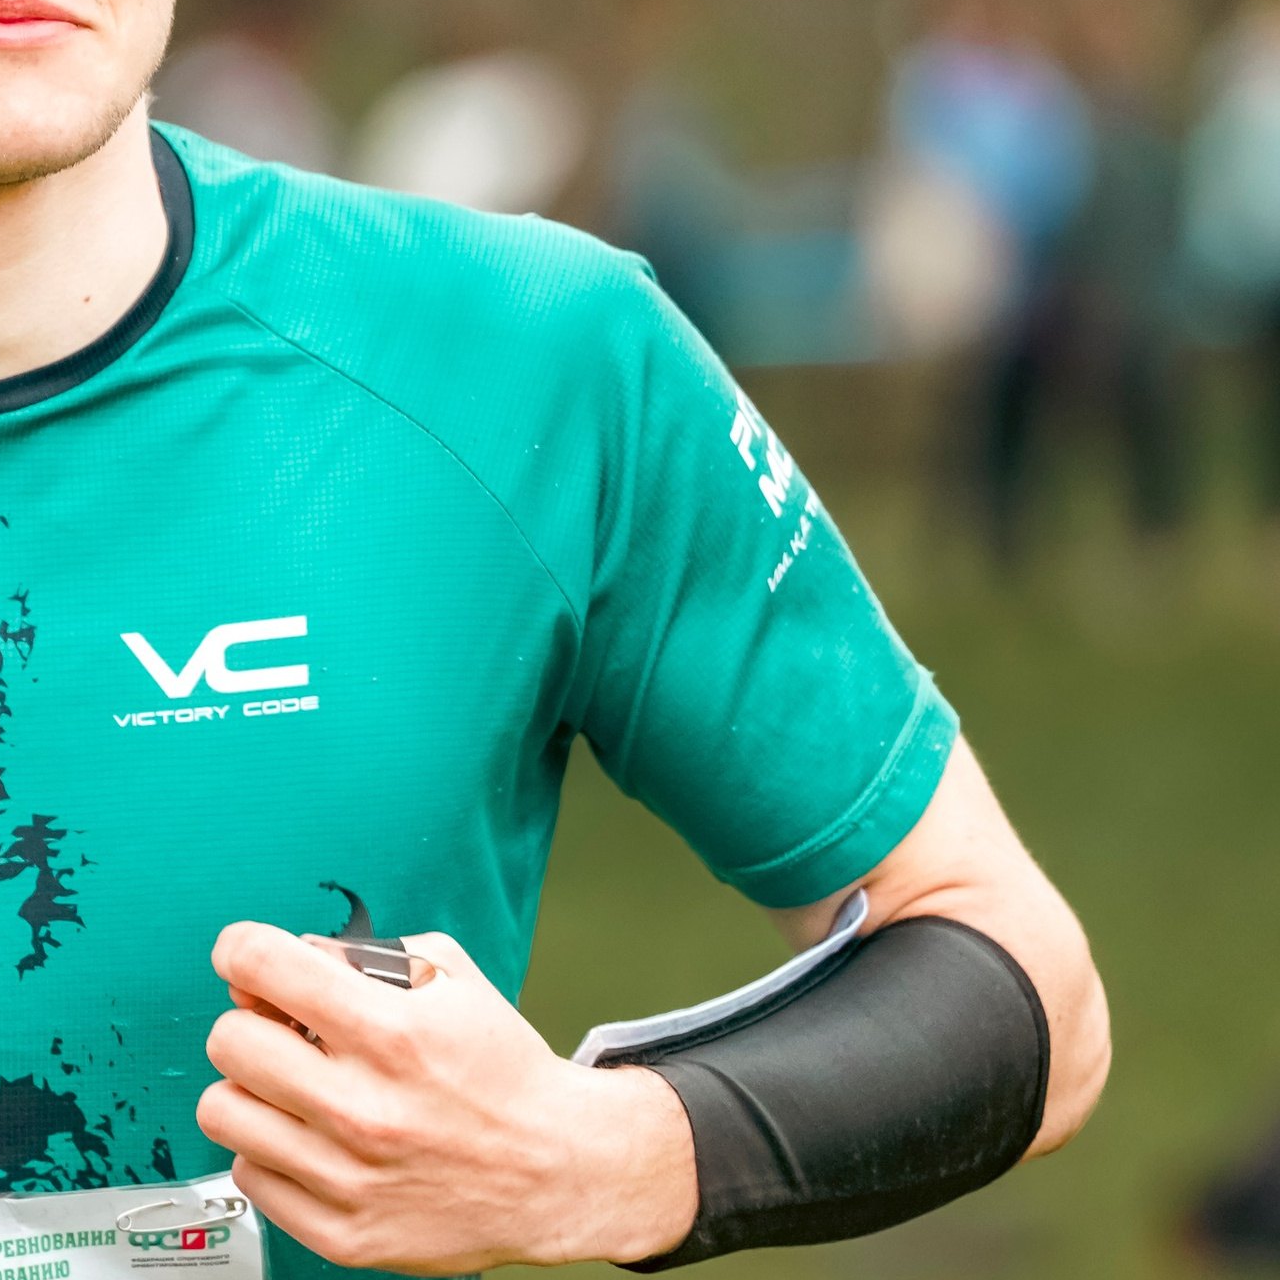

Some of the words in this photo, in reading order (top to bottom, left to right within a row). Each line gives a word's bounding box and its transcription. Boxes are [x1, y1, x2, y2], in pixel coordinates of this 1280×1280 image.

[119, 615, 310, 699] VC
[112, 705, 231, 728] VICTORY
[242, 695, 320, 717] CODE
